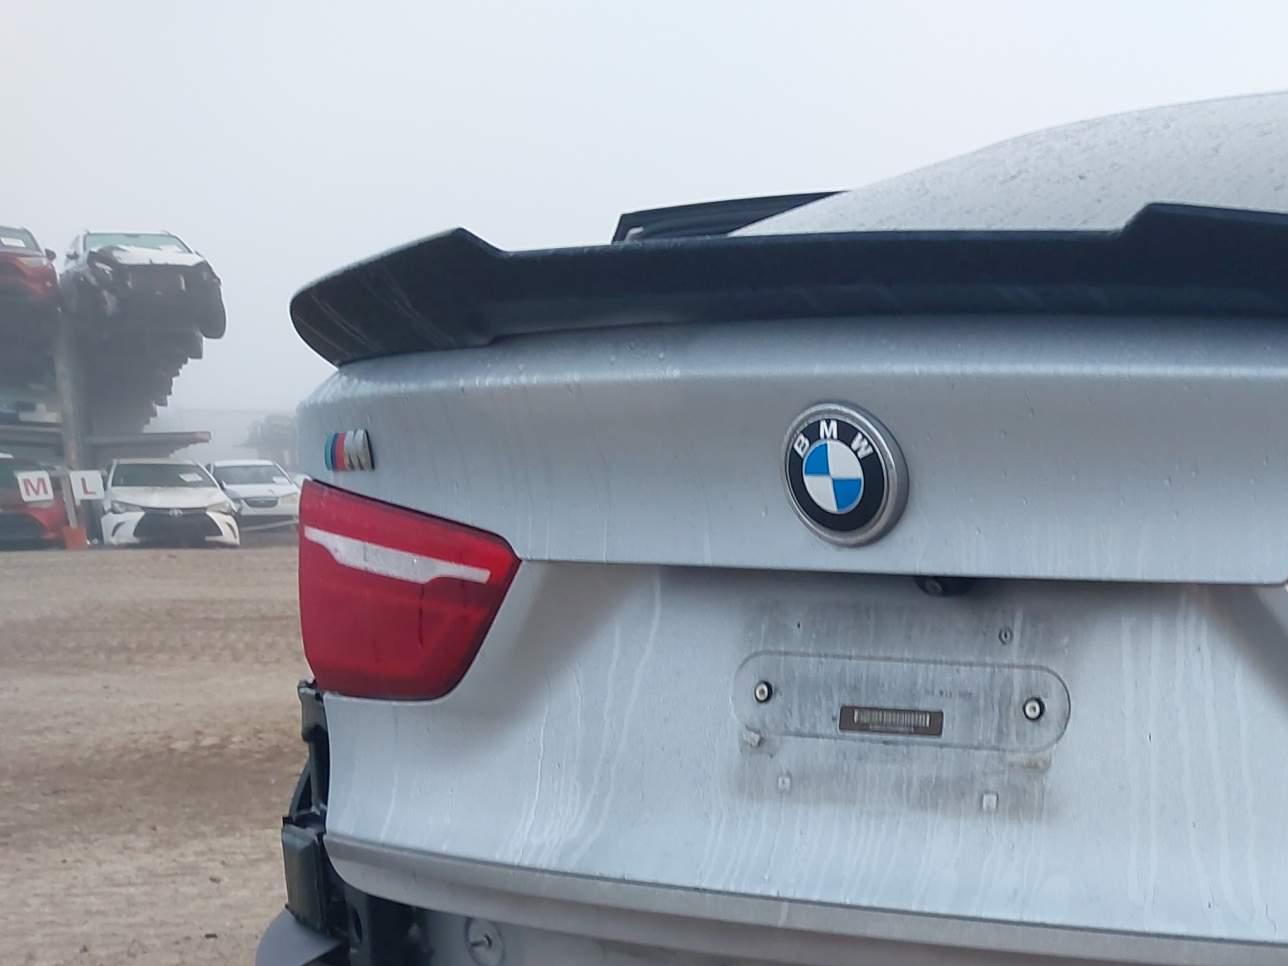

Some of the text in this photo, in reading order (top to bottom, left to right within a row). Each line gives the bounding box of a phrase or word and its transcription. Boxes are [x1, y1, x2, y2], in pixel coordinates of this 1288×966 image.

[793, 419, 875, 460] BMW
[23, 477, 49, 497] M
[81, 477, 97, 495] L
